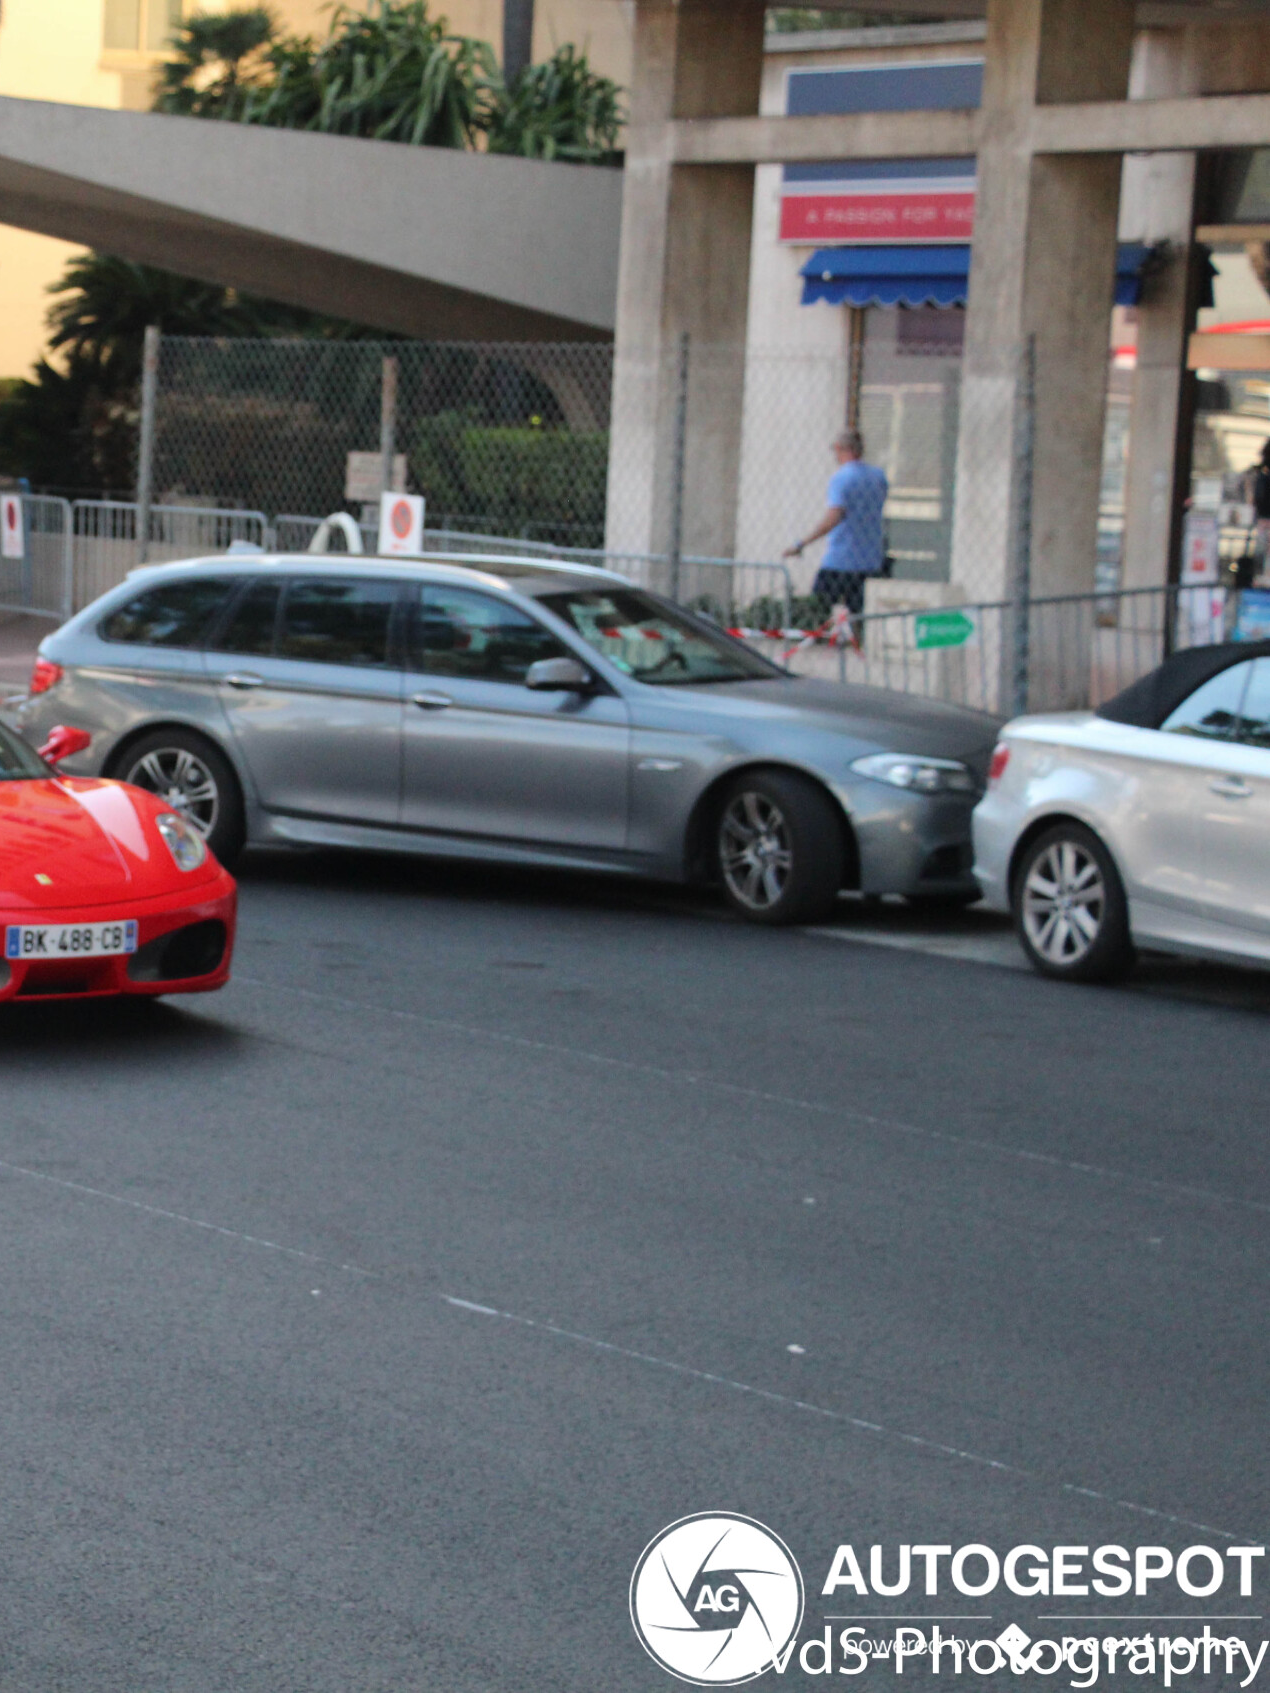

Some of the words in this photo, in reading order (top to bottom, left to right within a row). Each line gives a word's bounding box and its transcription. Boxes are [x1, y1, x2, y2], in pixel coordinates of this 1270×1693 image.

[823, 207, 897, 224] PASSION
[901, 206, 938, 223] FOR
[23, 926, 123, 953] BK-488-CB
